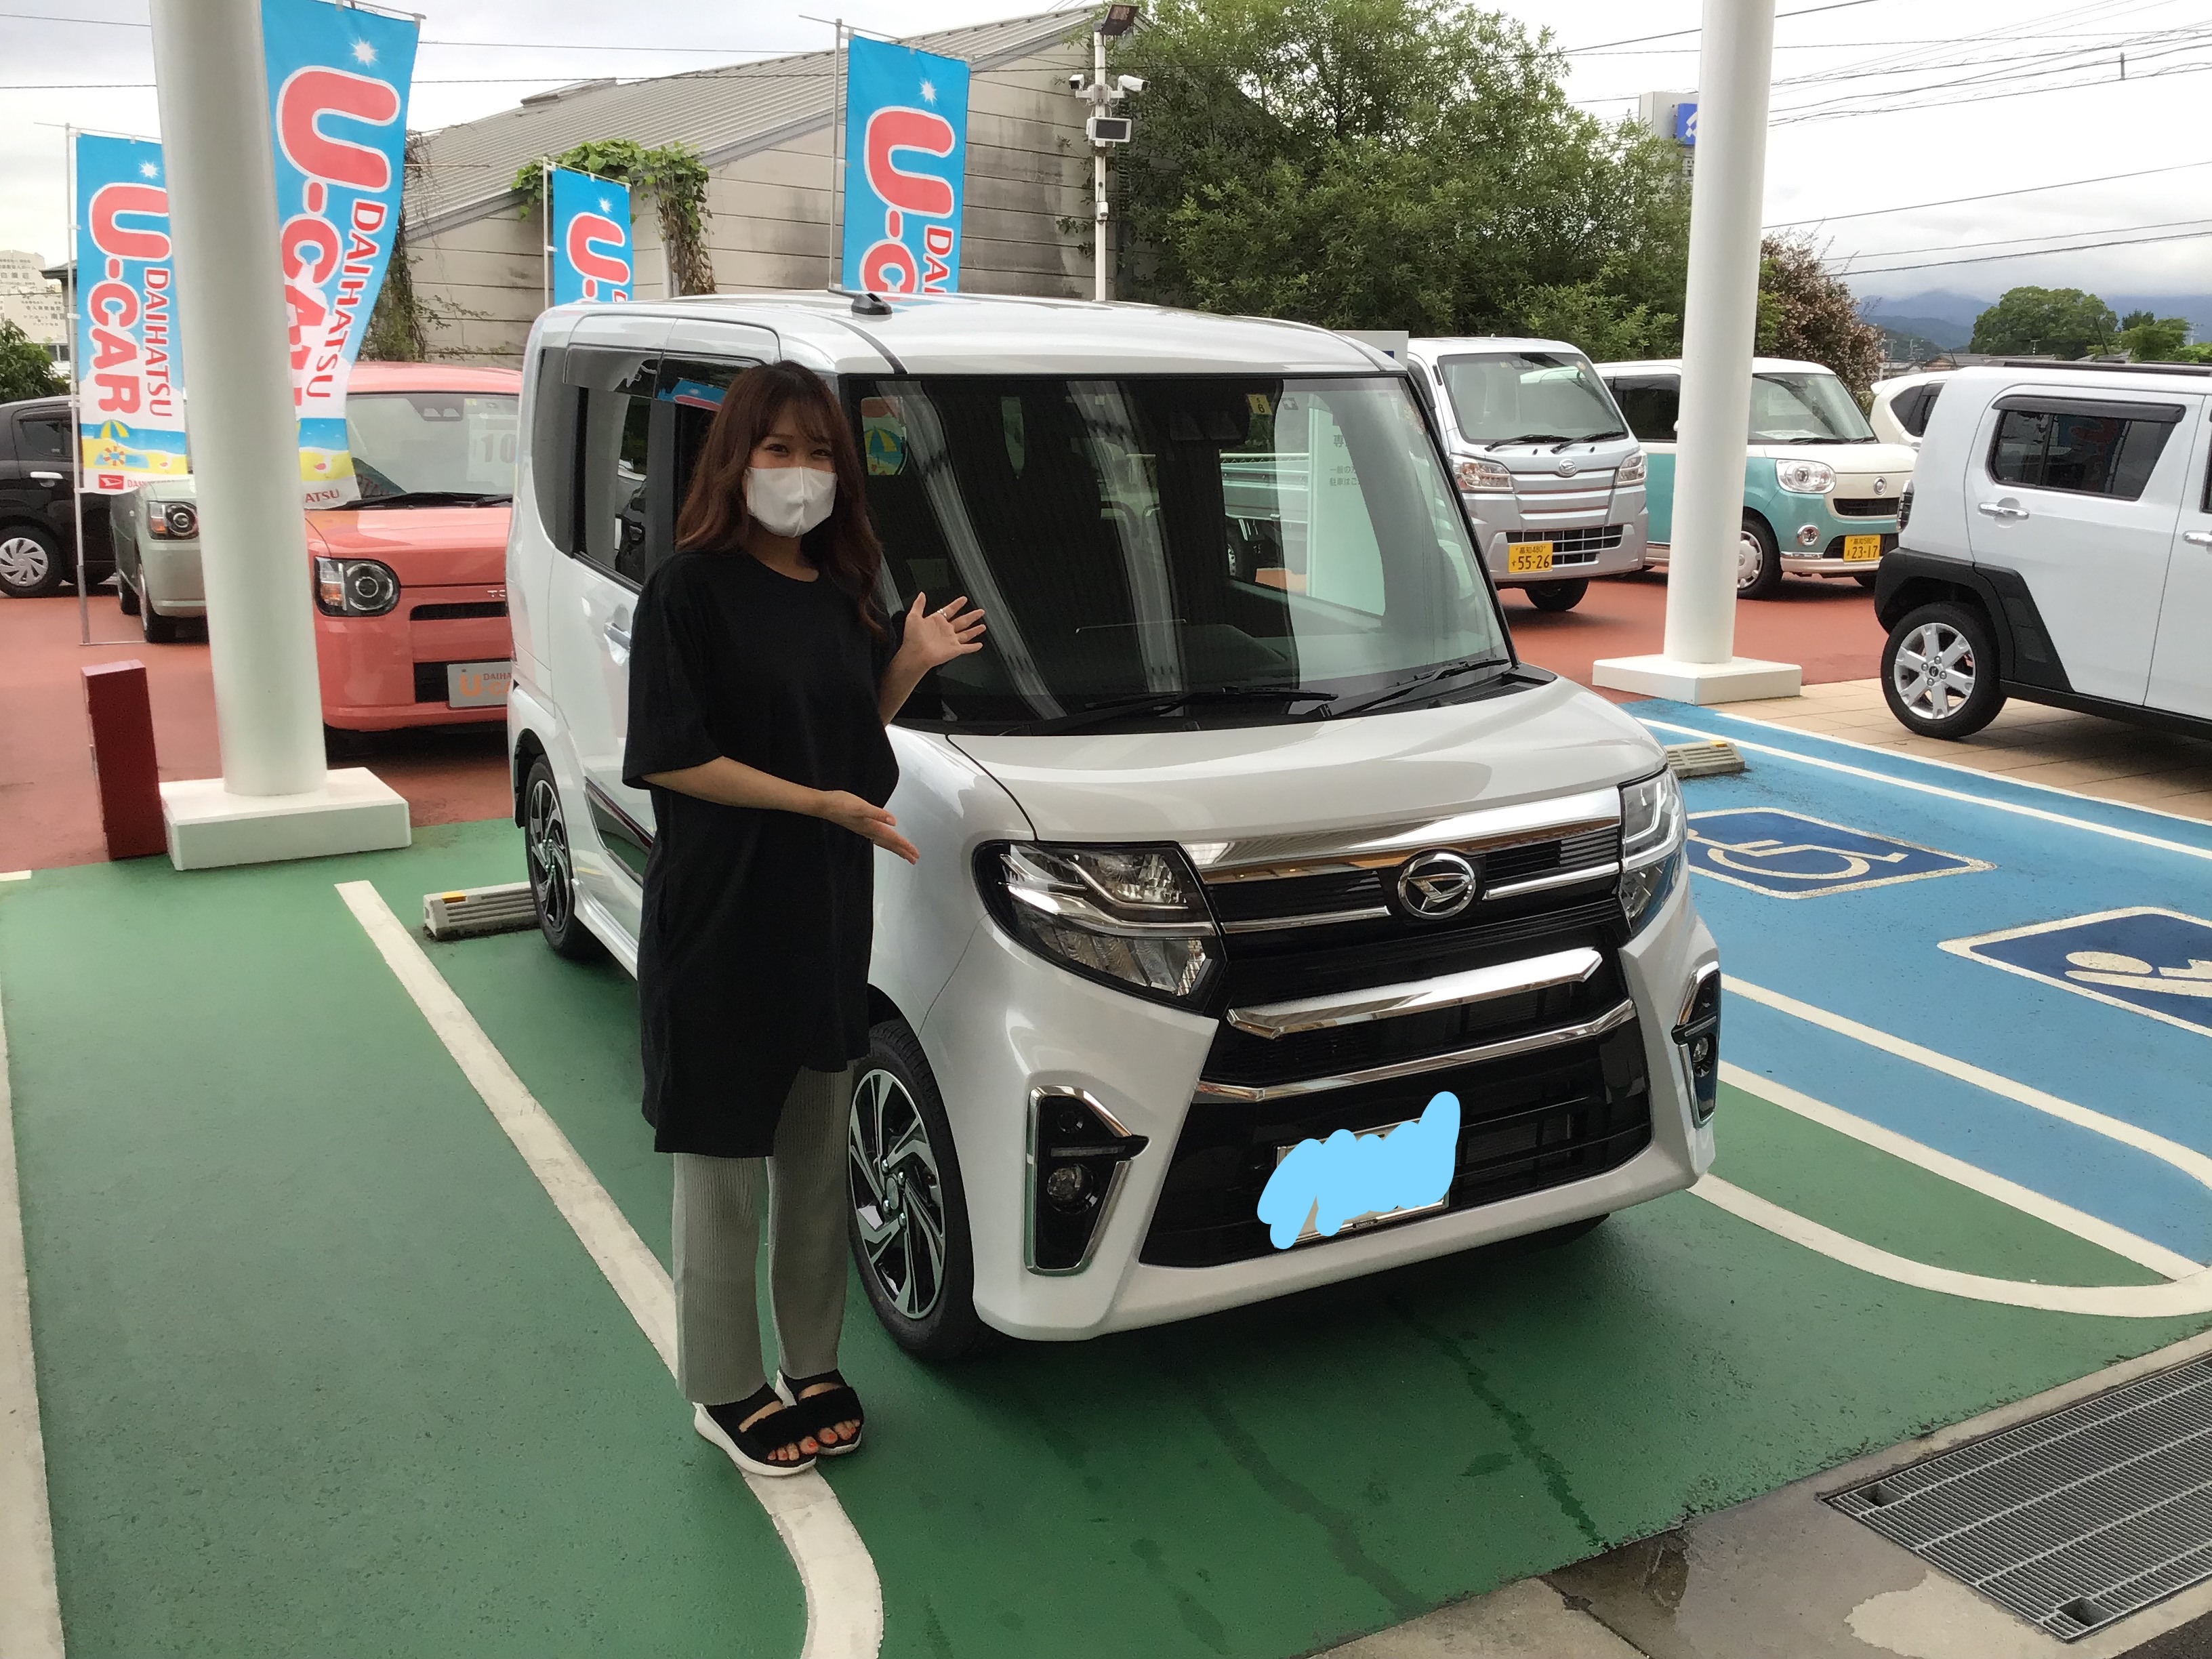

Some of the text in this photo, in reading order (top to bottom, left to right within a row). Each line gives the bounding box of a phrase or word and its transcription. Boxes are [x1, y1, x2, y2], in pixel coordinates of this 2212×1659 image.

[88, 182, 171, 414] U-CAR
[306, 199, 388, 398] DAIHATSU
[567, 212, 630, 302] U-
[144, 267, 173, 417] DAIHATSU
[1518, 554, 1550, 570] 55-26
[1851, 545, 1878, 558] 23-17
